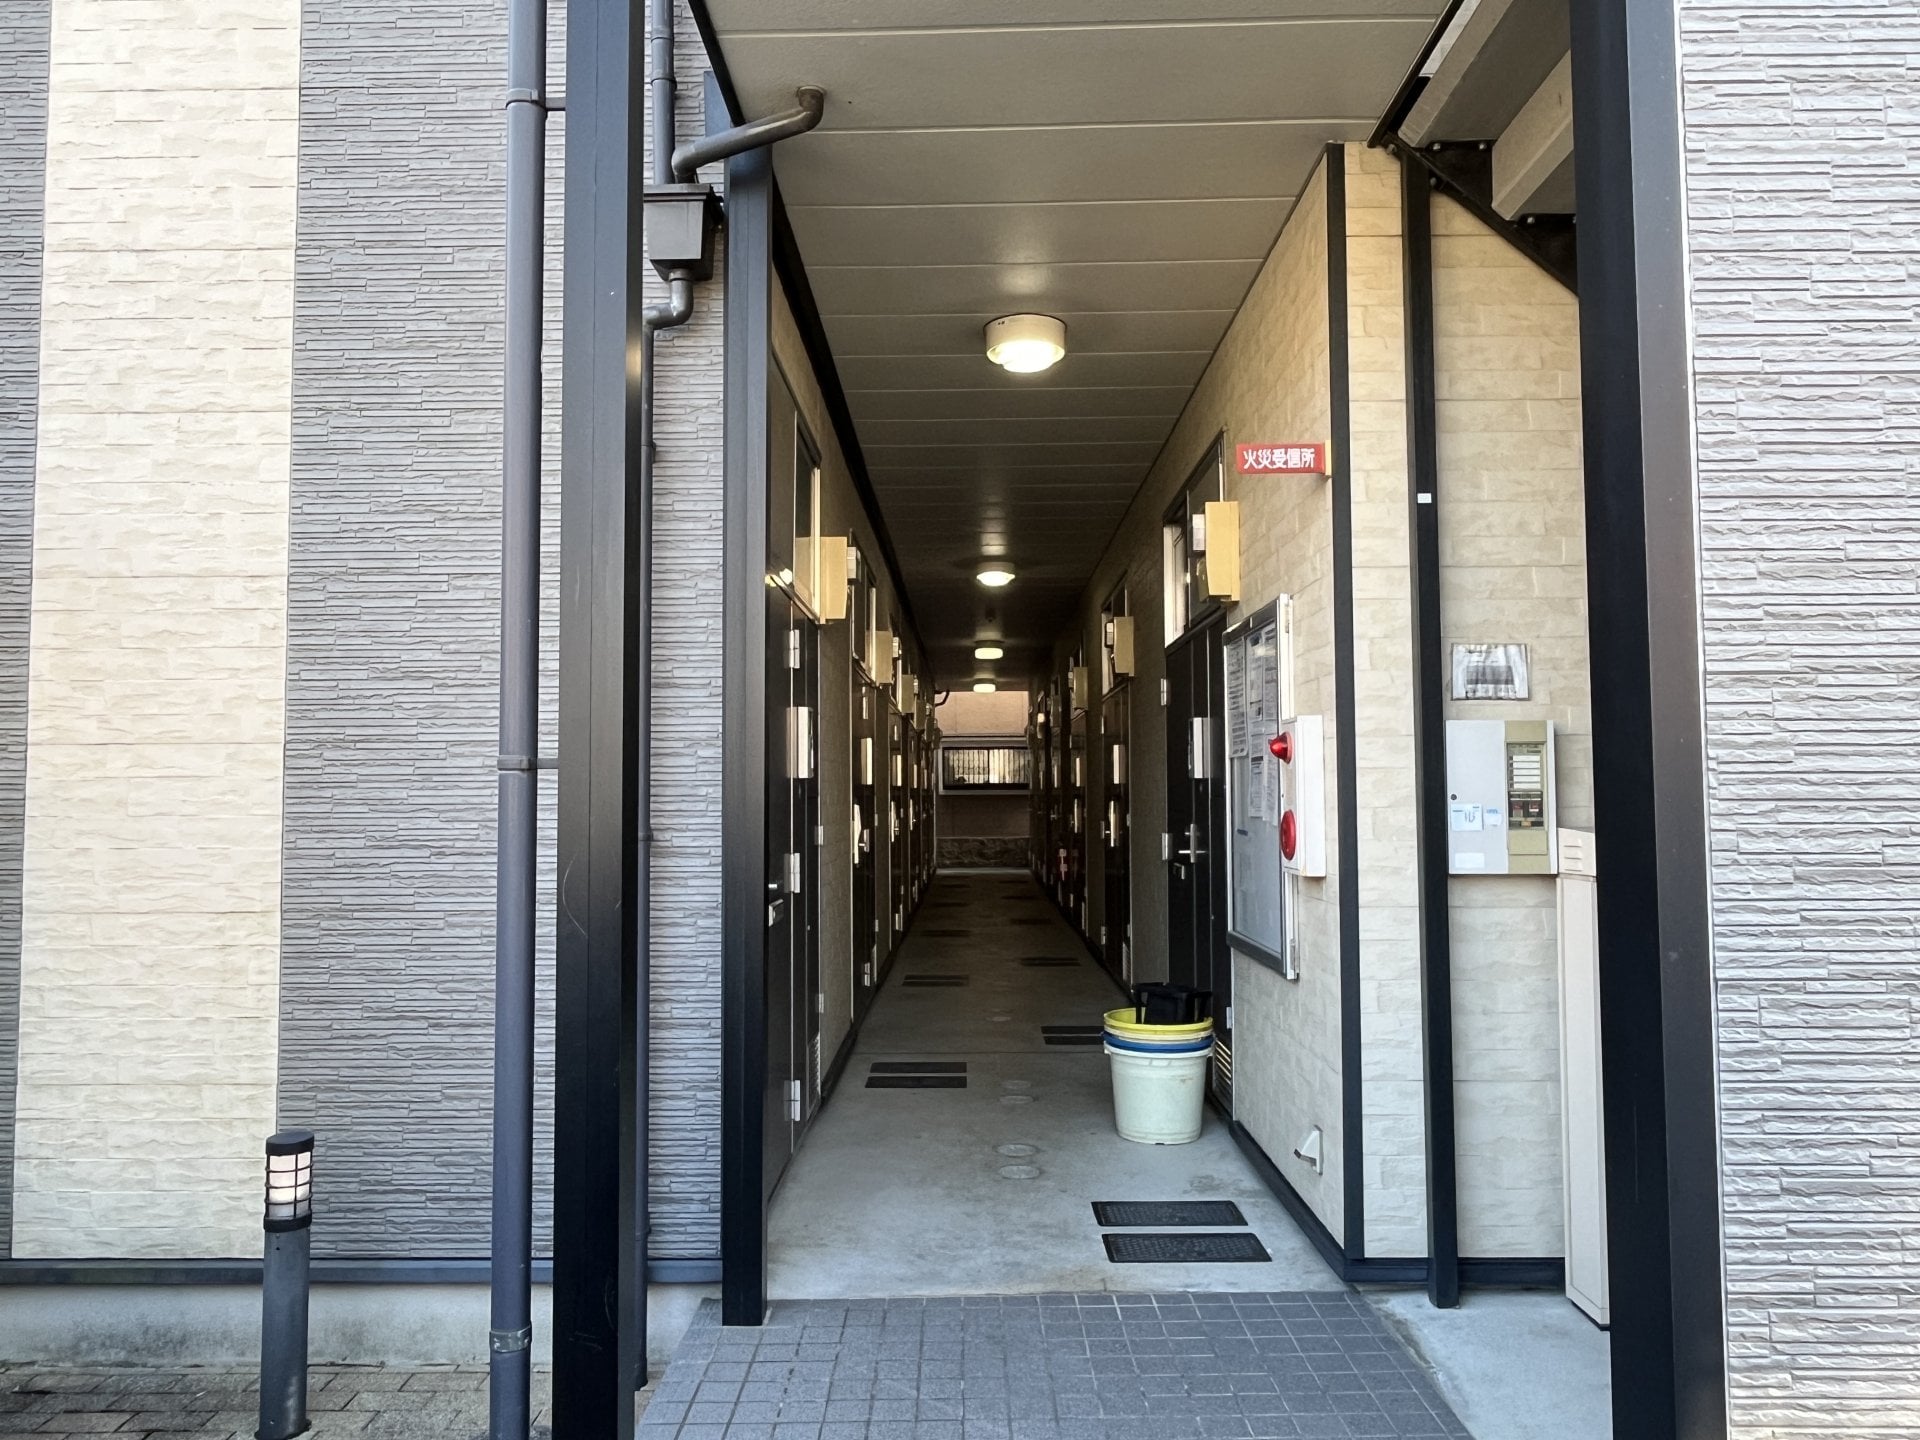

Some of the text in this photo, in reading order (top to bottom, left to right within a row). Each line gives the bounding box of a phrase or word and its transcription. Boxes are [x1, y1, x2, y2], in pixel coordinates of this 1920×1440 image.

[1243, 448, 1315, 469] 火災受信所
